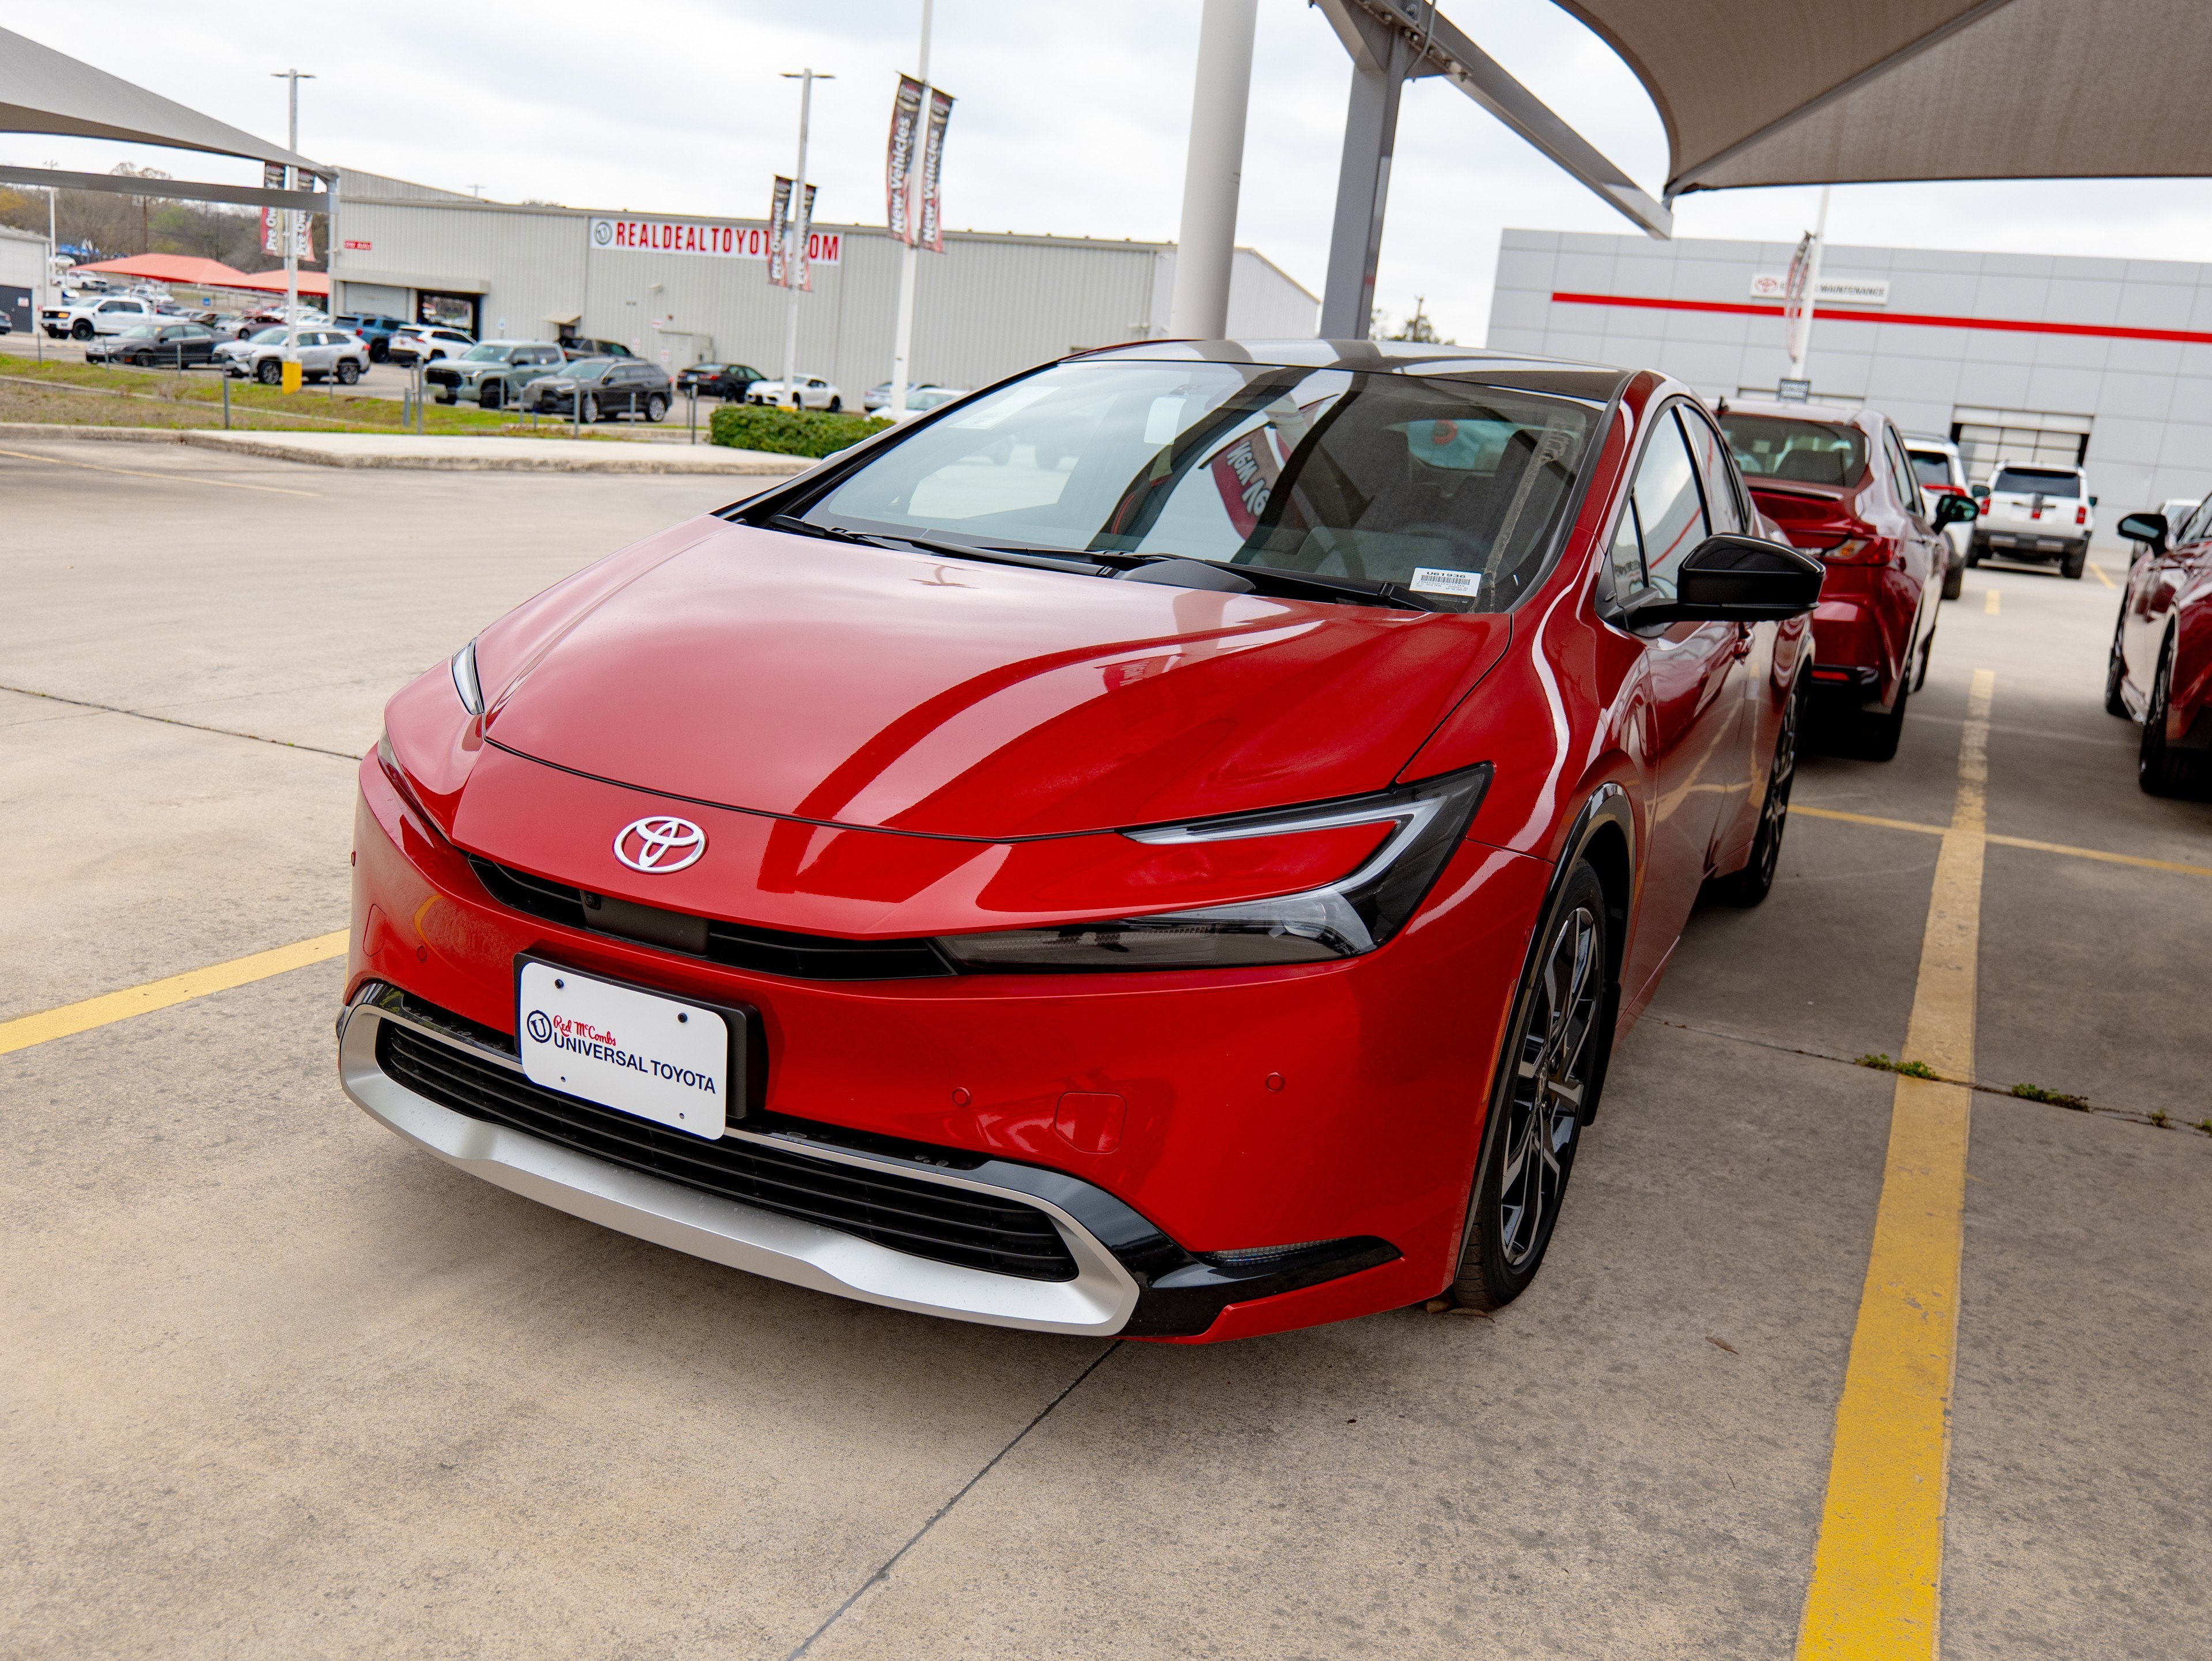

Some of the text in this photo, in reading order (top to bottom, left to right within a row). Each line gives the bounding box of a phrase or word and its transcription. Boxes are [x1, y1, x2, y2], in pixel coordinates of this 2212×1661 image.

[891, 116, 911, 191] Vehicles
[923, 128, 940, 243] New Vehicles
[771, 202, 785, 253] Owned
[892, 194, 904, 234] New
[616, 222, 839, 261] REALDEALTOYOT.OM
[771, 255, 782, 280] Pre
[553, 1015, 572, 1037] Red
[573, 1020, 616, 1046] McCombs
[554, 1032, 716, 1095] UNIVERSAL TOYOTA
